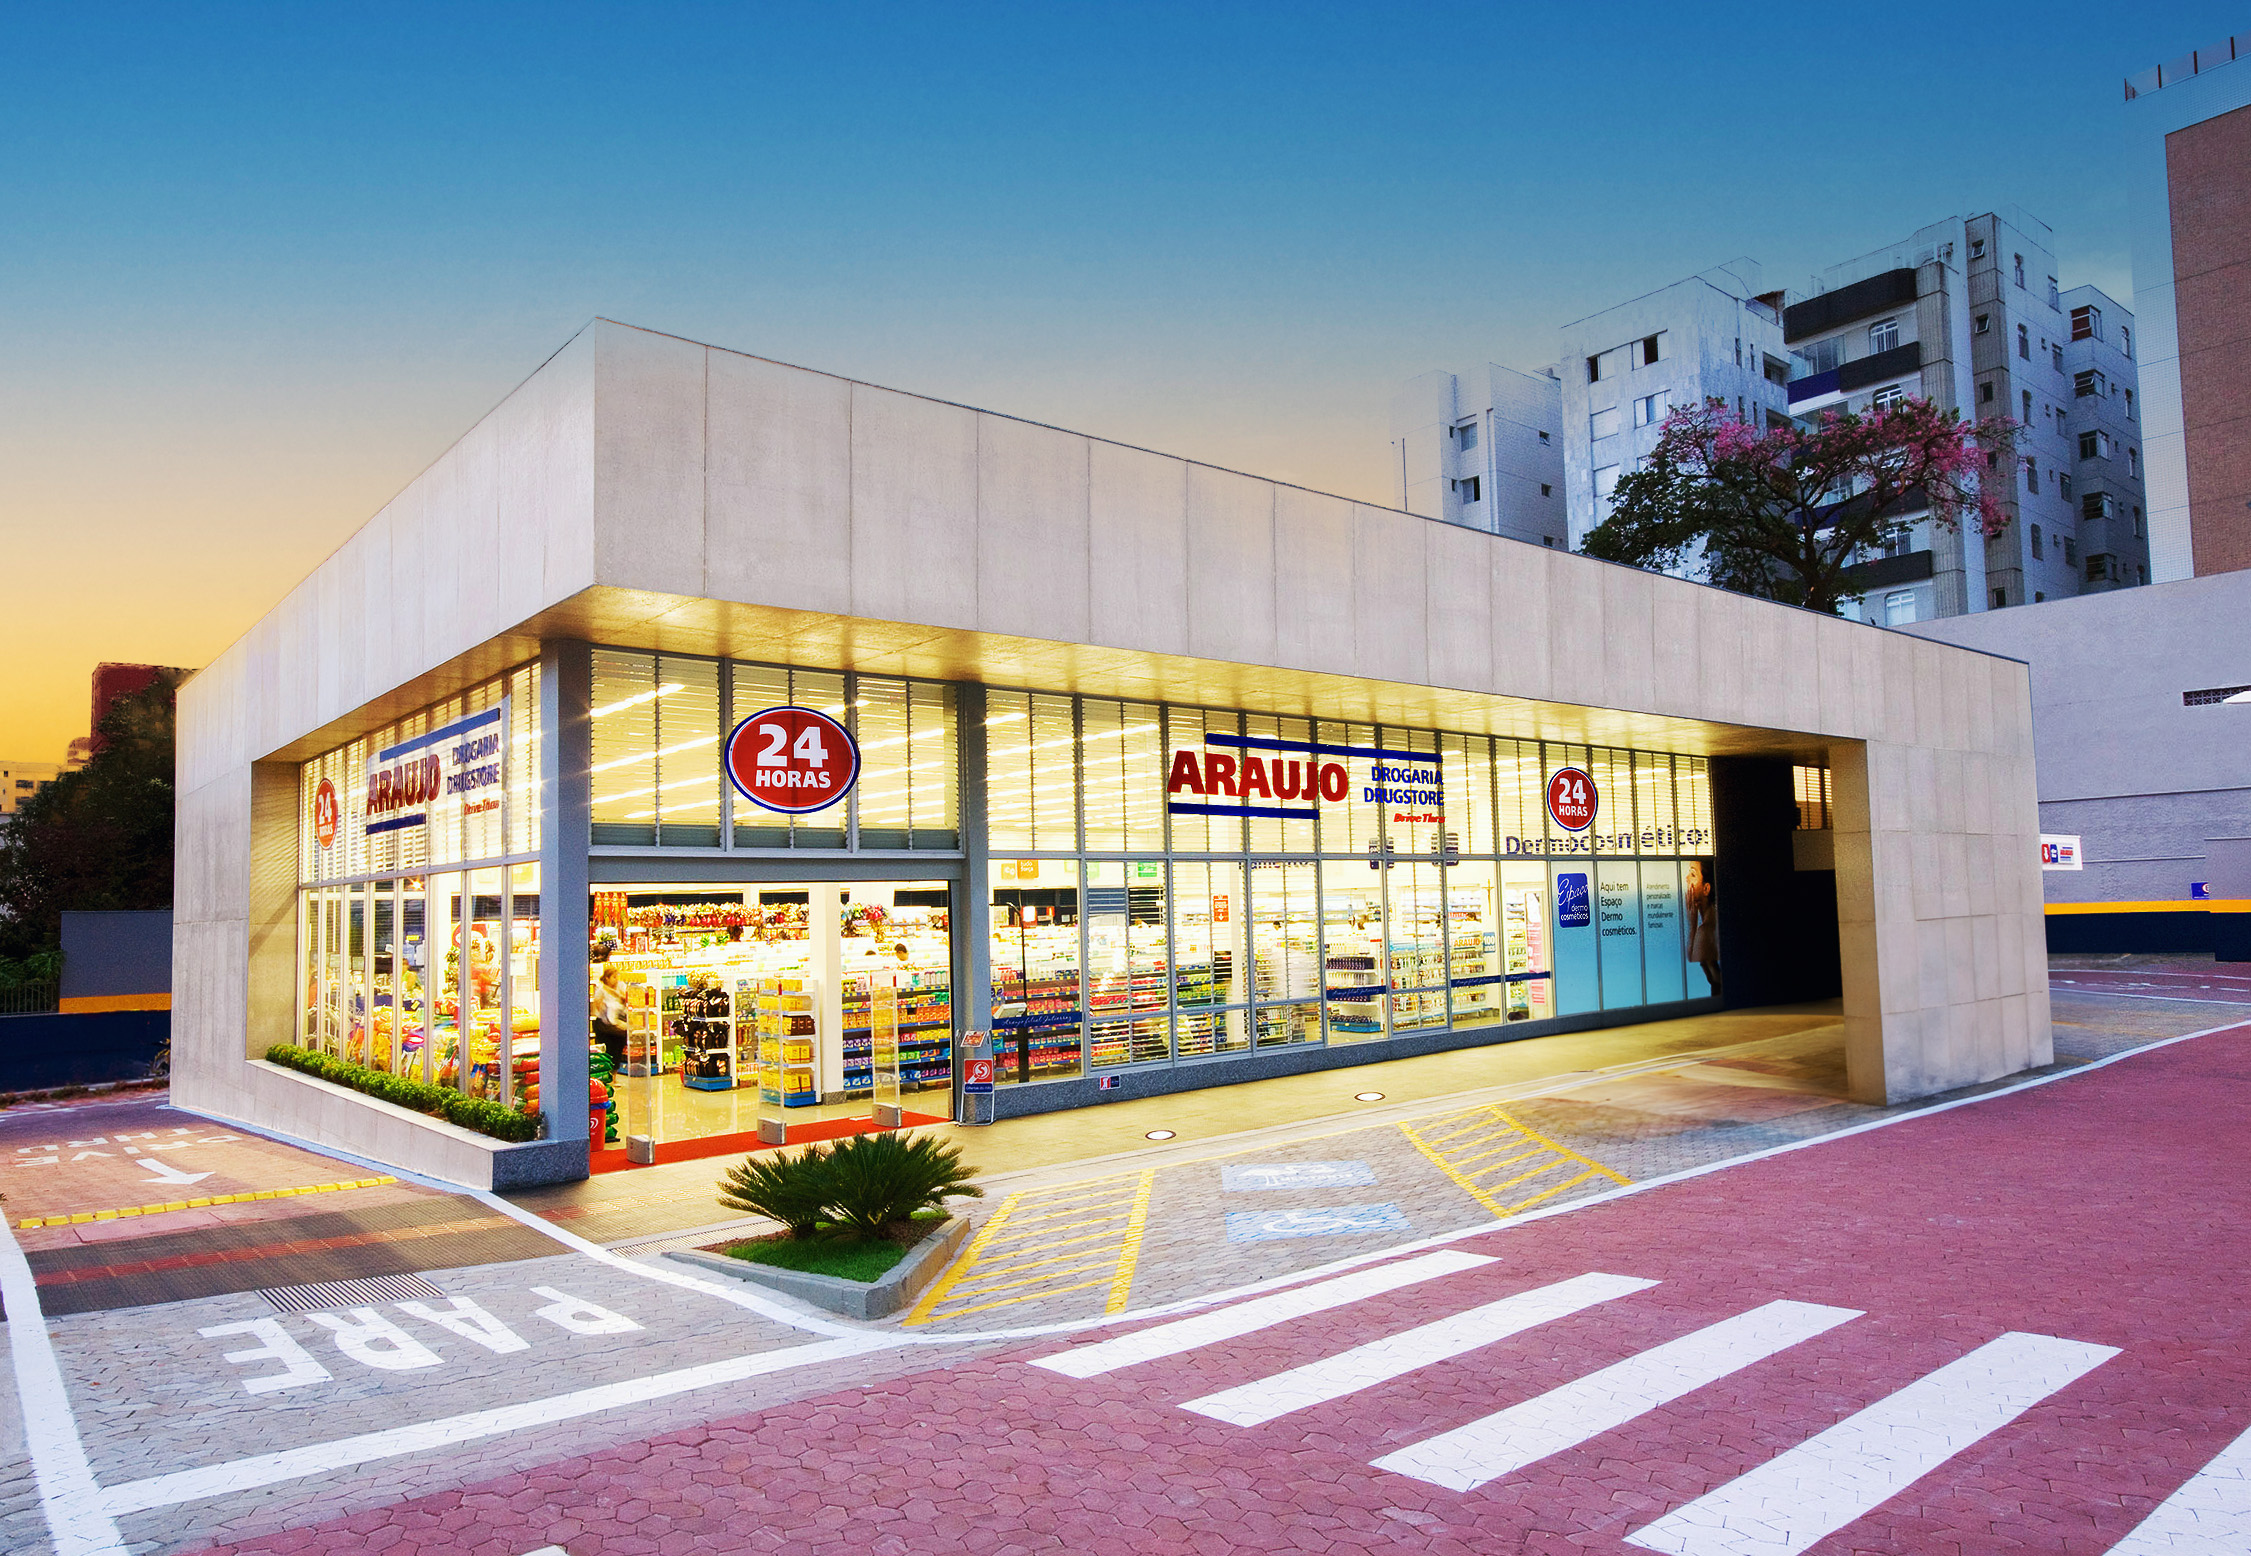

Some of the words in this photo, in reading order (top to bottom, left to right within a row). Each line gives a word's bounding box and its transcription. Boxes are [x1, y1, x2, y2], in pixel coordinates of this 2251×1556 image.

[453, 733, 499, 766] DROGARIA
[757, 723, 828, 768] 24
[366, 753, 441, 815] ARAUJO
[447, 763, 500, 795] DRUGSTORE
[755, 769, 832, 788] HORAS
[1166, 750, 1349, 802] ARAUJO
[1371, 766, 1444, 785] DROGARIA
[1364, 787, 1444, 806] DRUGSTORE
[1558, 777, 1587, 805] 24
[318, 791, 333, 825] 24
[1558, 804, 1589, 817] HORAS
[1394, 812, 1422, 823] Drive
[1422, 812, 1446, 824] Thru
[1600, 882, 1615, 893] Aqui
[1616, 882, 1629, 891] tem
[1571, 904, 1589, 912] dermo
[1601, 896, 1623, 909] Espaço
[1560, 912, 1589, 921] cosméticos
[1601, 911, 1624, 922] Dermo
[1602, 925, 1637, 937] cosméticos.
[1454, 937, 1481, 947] ARAUJO
[16, 1127, 205, 1154] THRU
[15, 1134, 243, 1168] DRIVE
[197, 1285, 647, 1394] PARE
